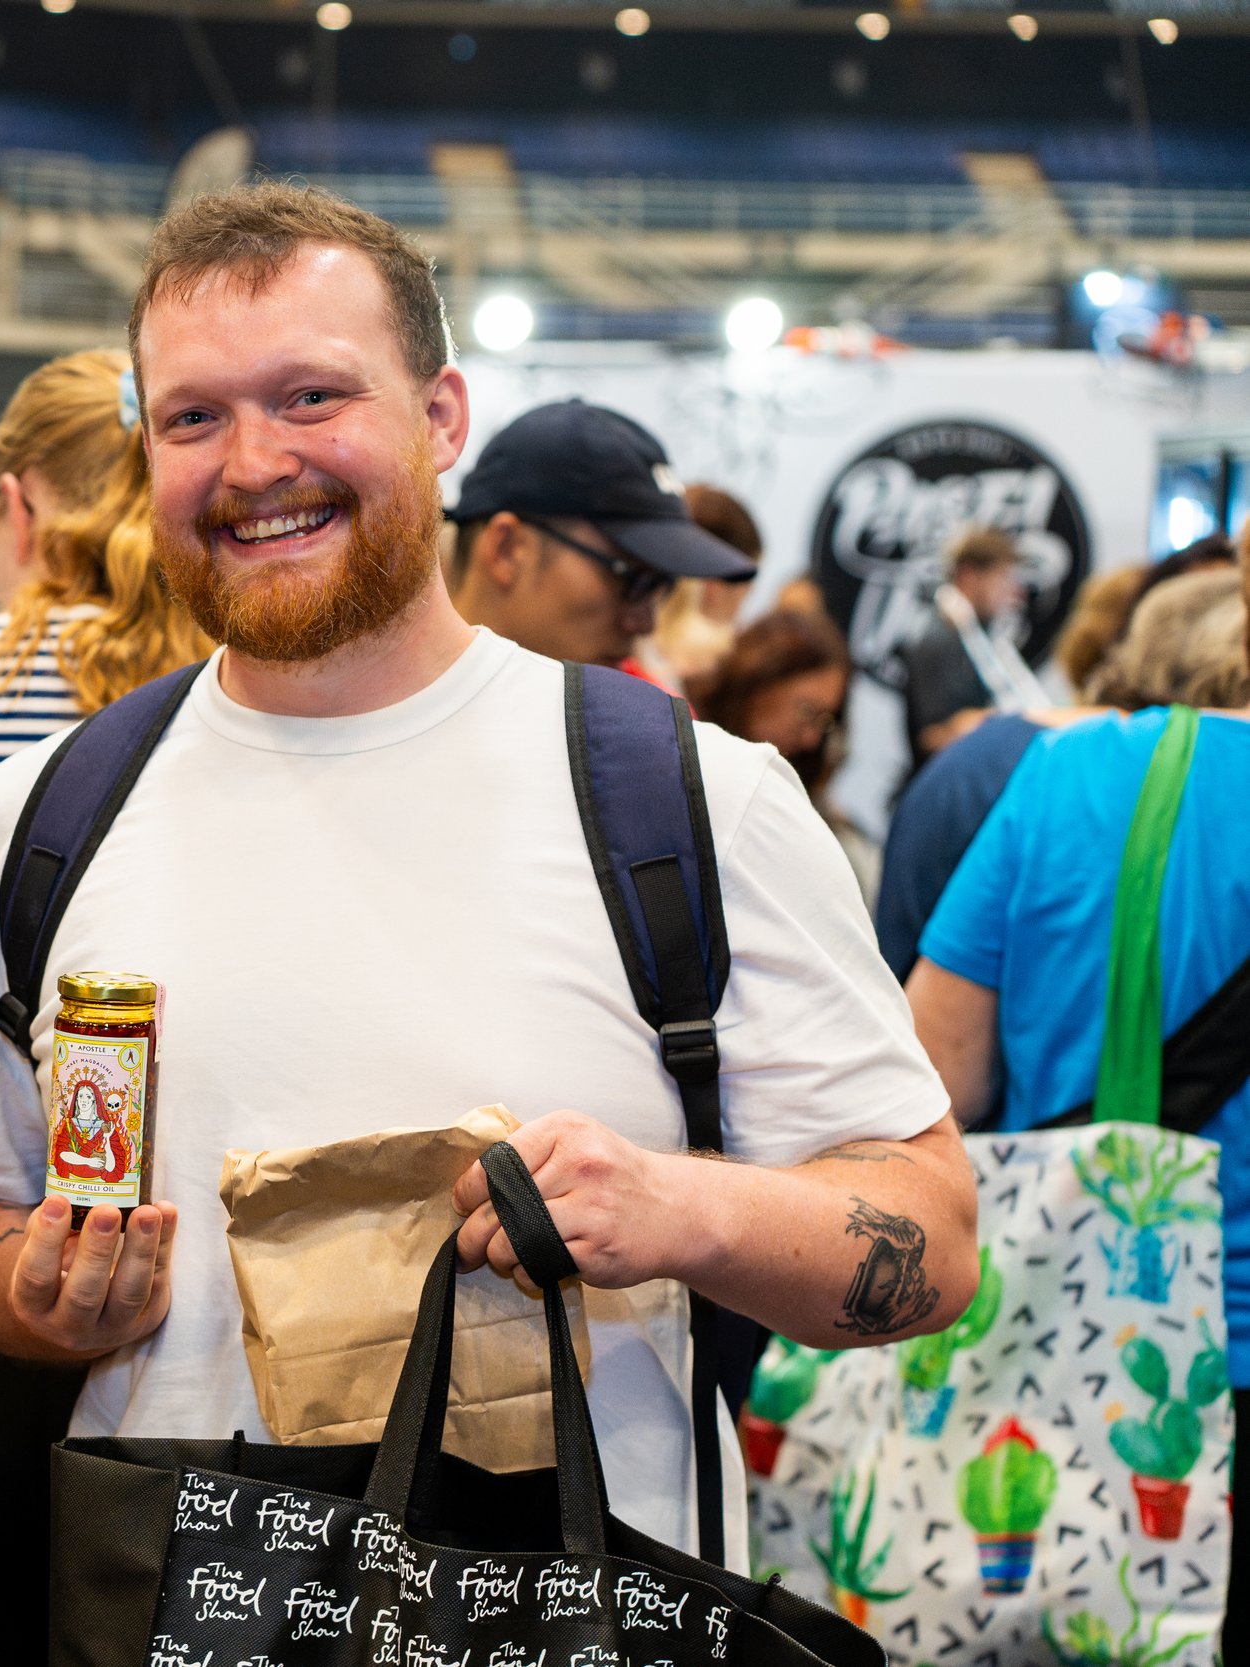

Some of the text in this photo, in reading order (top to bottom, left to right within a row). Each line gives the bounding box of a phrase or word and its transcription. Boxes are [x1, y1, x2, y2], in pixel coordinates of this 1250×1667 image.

[77, 1045, 106, 1053] APOSTLE
[81, 1058, 112, 1075] MAGDALENE
[57, 1180, 76, 1189] CRISPY
[78, 1184, 100, 1192] CHILLI
[184, 1473, 216, 1491] The
[177, 1488, 239, 1527] ood
[275, 1492, 311, 1511] The
[173, 1510, 221, 1533] Show
[256, 1498, 335, 1547] Food
[263, 1530, 317, 1552] Show
[351, 1517, 399, 1553] Foo
[207, 1562, 244, 1581] The
[475, 1559, 508, 1575] The
[550, 1559, 581, 1575] The
[187, 1567, 267, 1617] Food
[303, 1581, 338, 1599] The
[456, 1566, 525, 1605] Food
[534, 1568, 603, 1608] Food
[631, 1572, 667, 1593] The
[195, 1600, 249, 1622] Show
[284, 1587, 360, 1634] Food
[468, 1598, 509, 1622] Show
[541, 1597, 590, 1622] Show
[613, 1576, 690, 1630] Food
[291, 1618, 340, 1641] Show
[371, 1609, 400, 1643] Fo
[622, 1608, 669, 1631] Show
[154, 1634, 191, 1654] The
[414, 1634, 449, 1654] The
[500, 1641, 527, 1656] The
[583, 1644, 620, 1661] The
